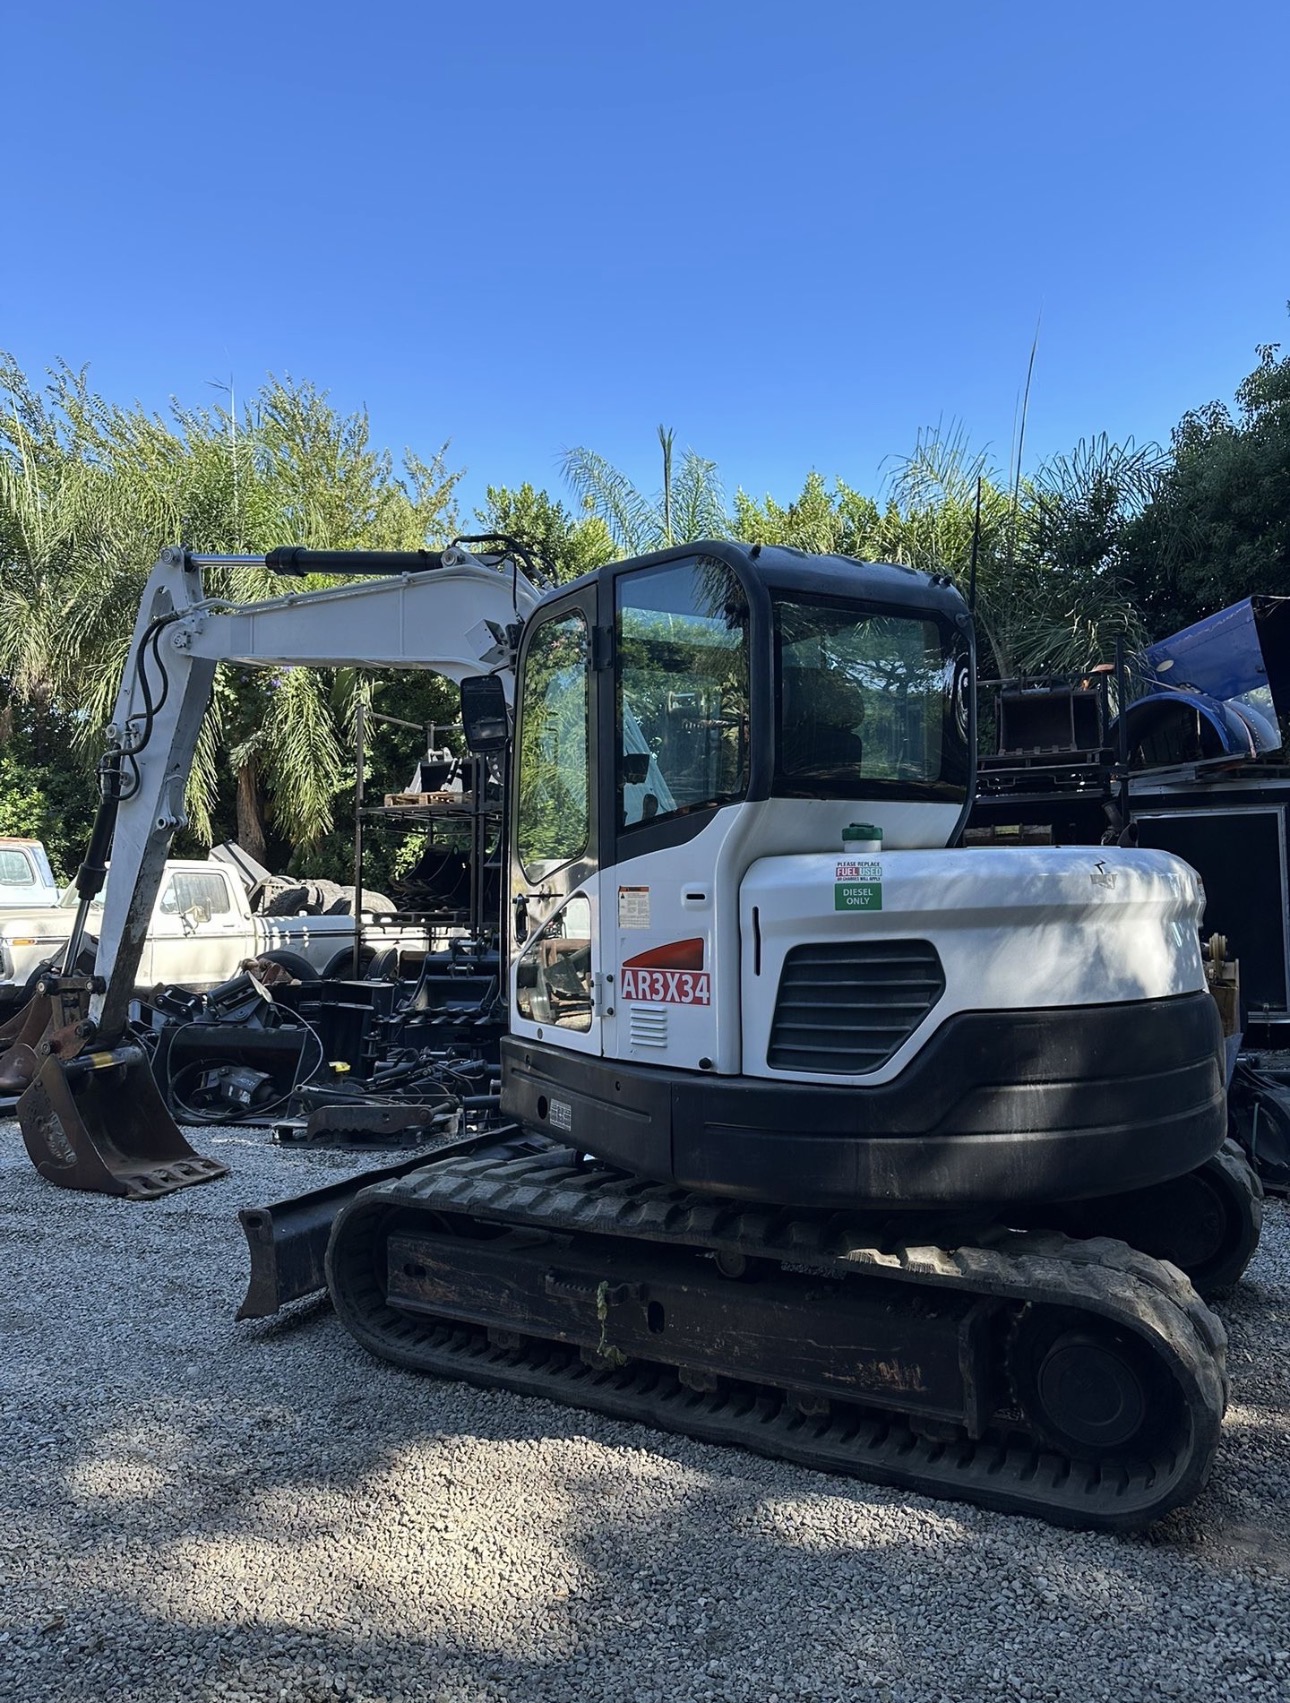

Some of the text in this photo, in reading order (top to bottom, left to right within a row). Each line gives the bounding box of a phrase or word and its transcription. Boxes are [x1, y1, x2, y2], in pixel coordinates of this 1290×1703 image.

[838, 868, 881, 876] FUEL USED
[843, 888, 873, 896] DIESEL
[622, 970, 710, 1004] AR3X34
